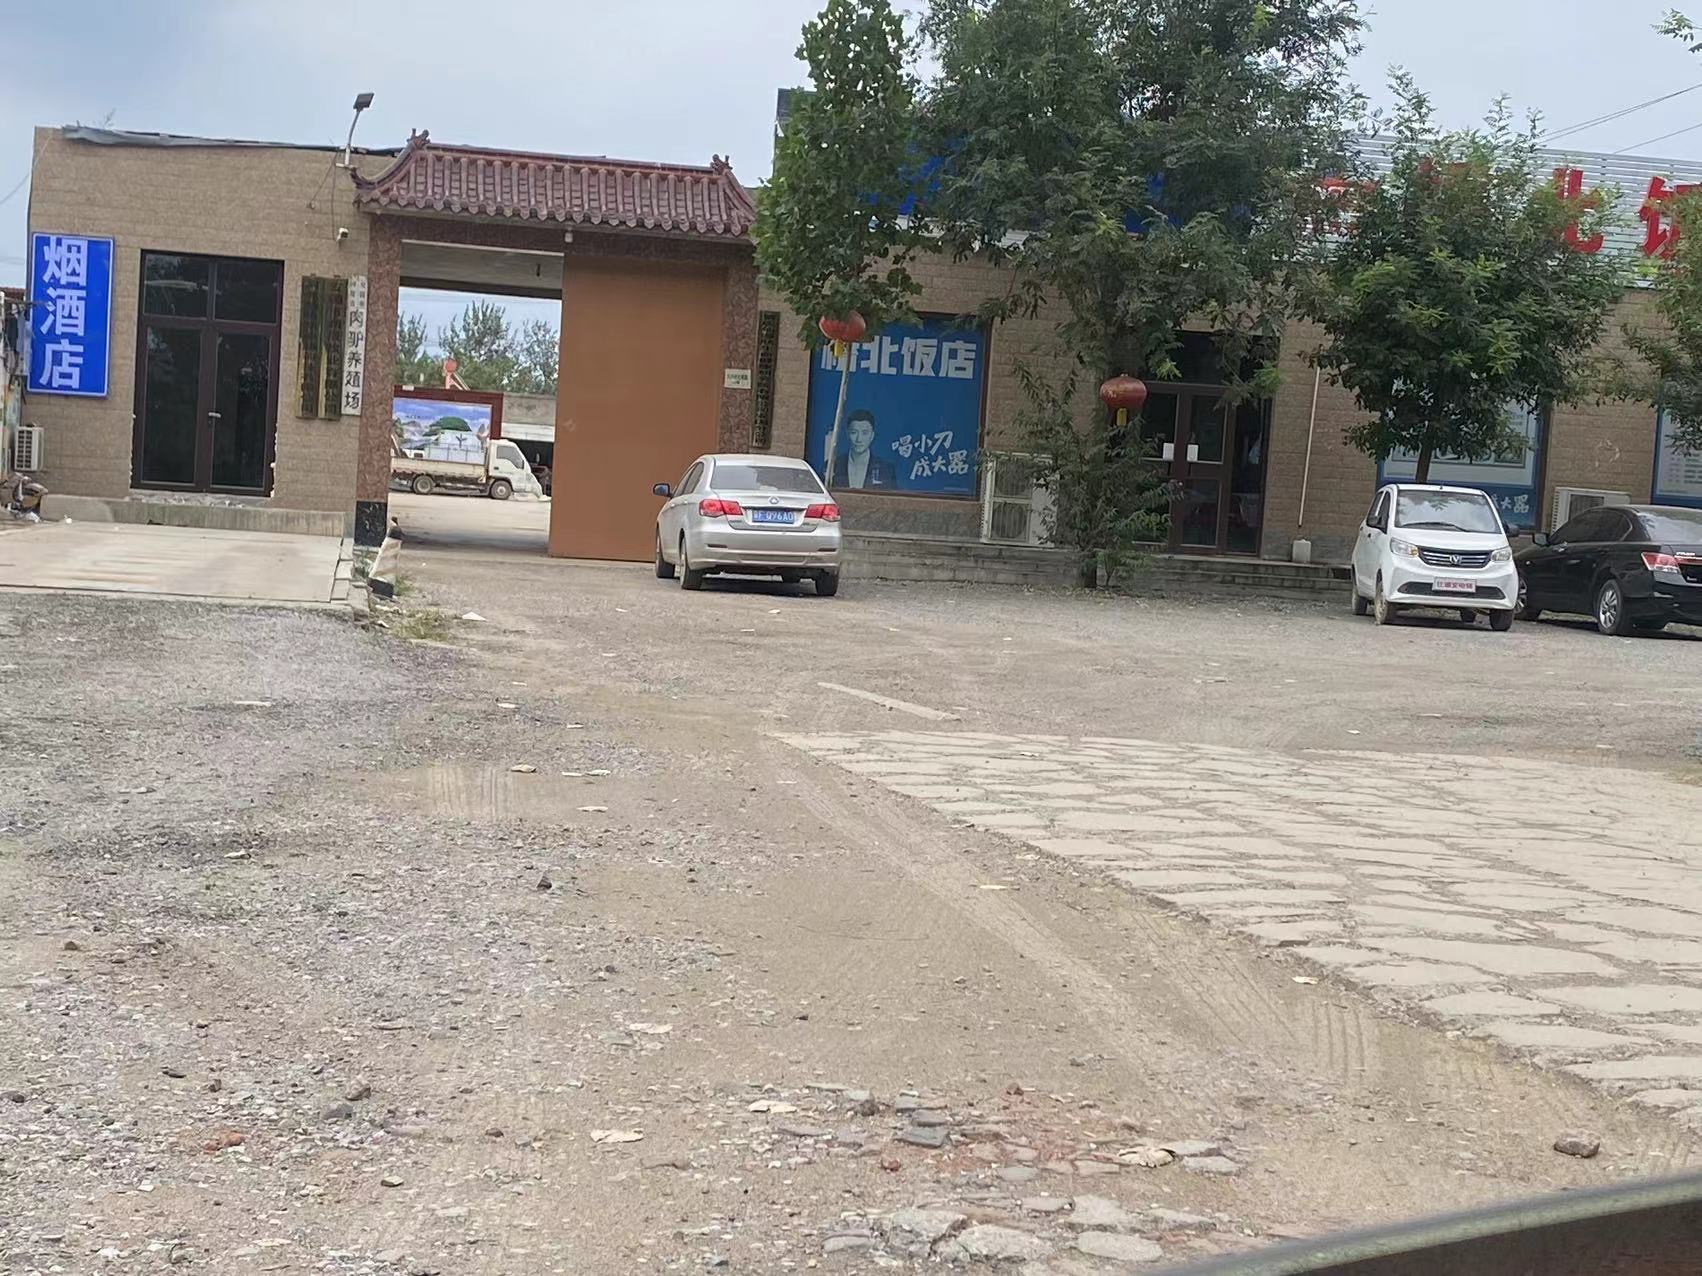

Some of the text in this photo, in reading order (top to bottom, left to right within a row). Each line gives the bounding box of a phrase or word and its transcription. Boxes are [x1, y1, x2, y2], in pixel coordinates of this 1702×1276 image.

[39, 236, 89, 390] 烟酒店
[344, 309, 364, 409] 肉驴养殖场
[892, 431, 953, 458] 喝小刀
[909, 450, 969, 480] 成大器
